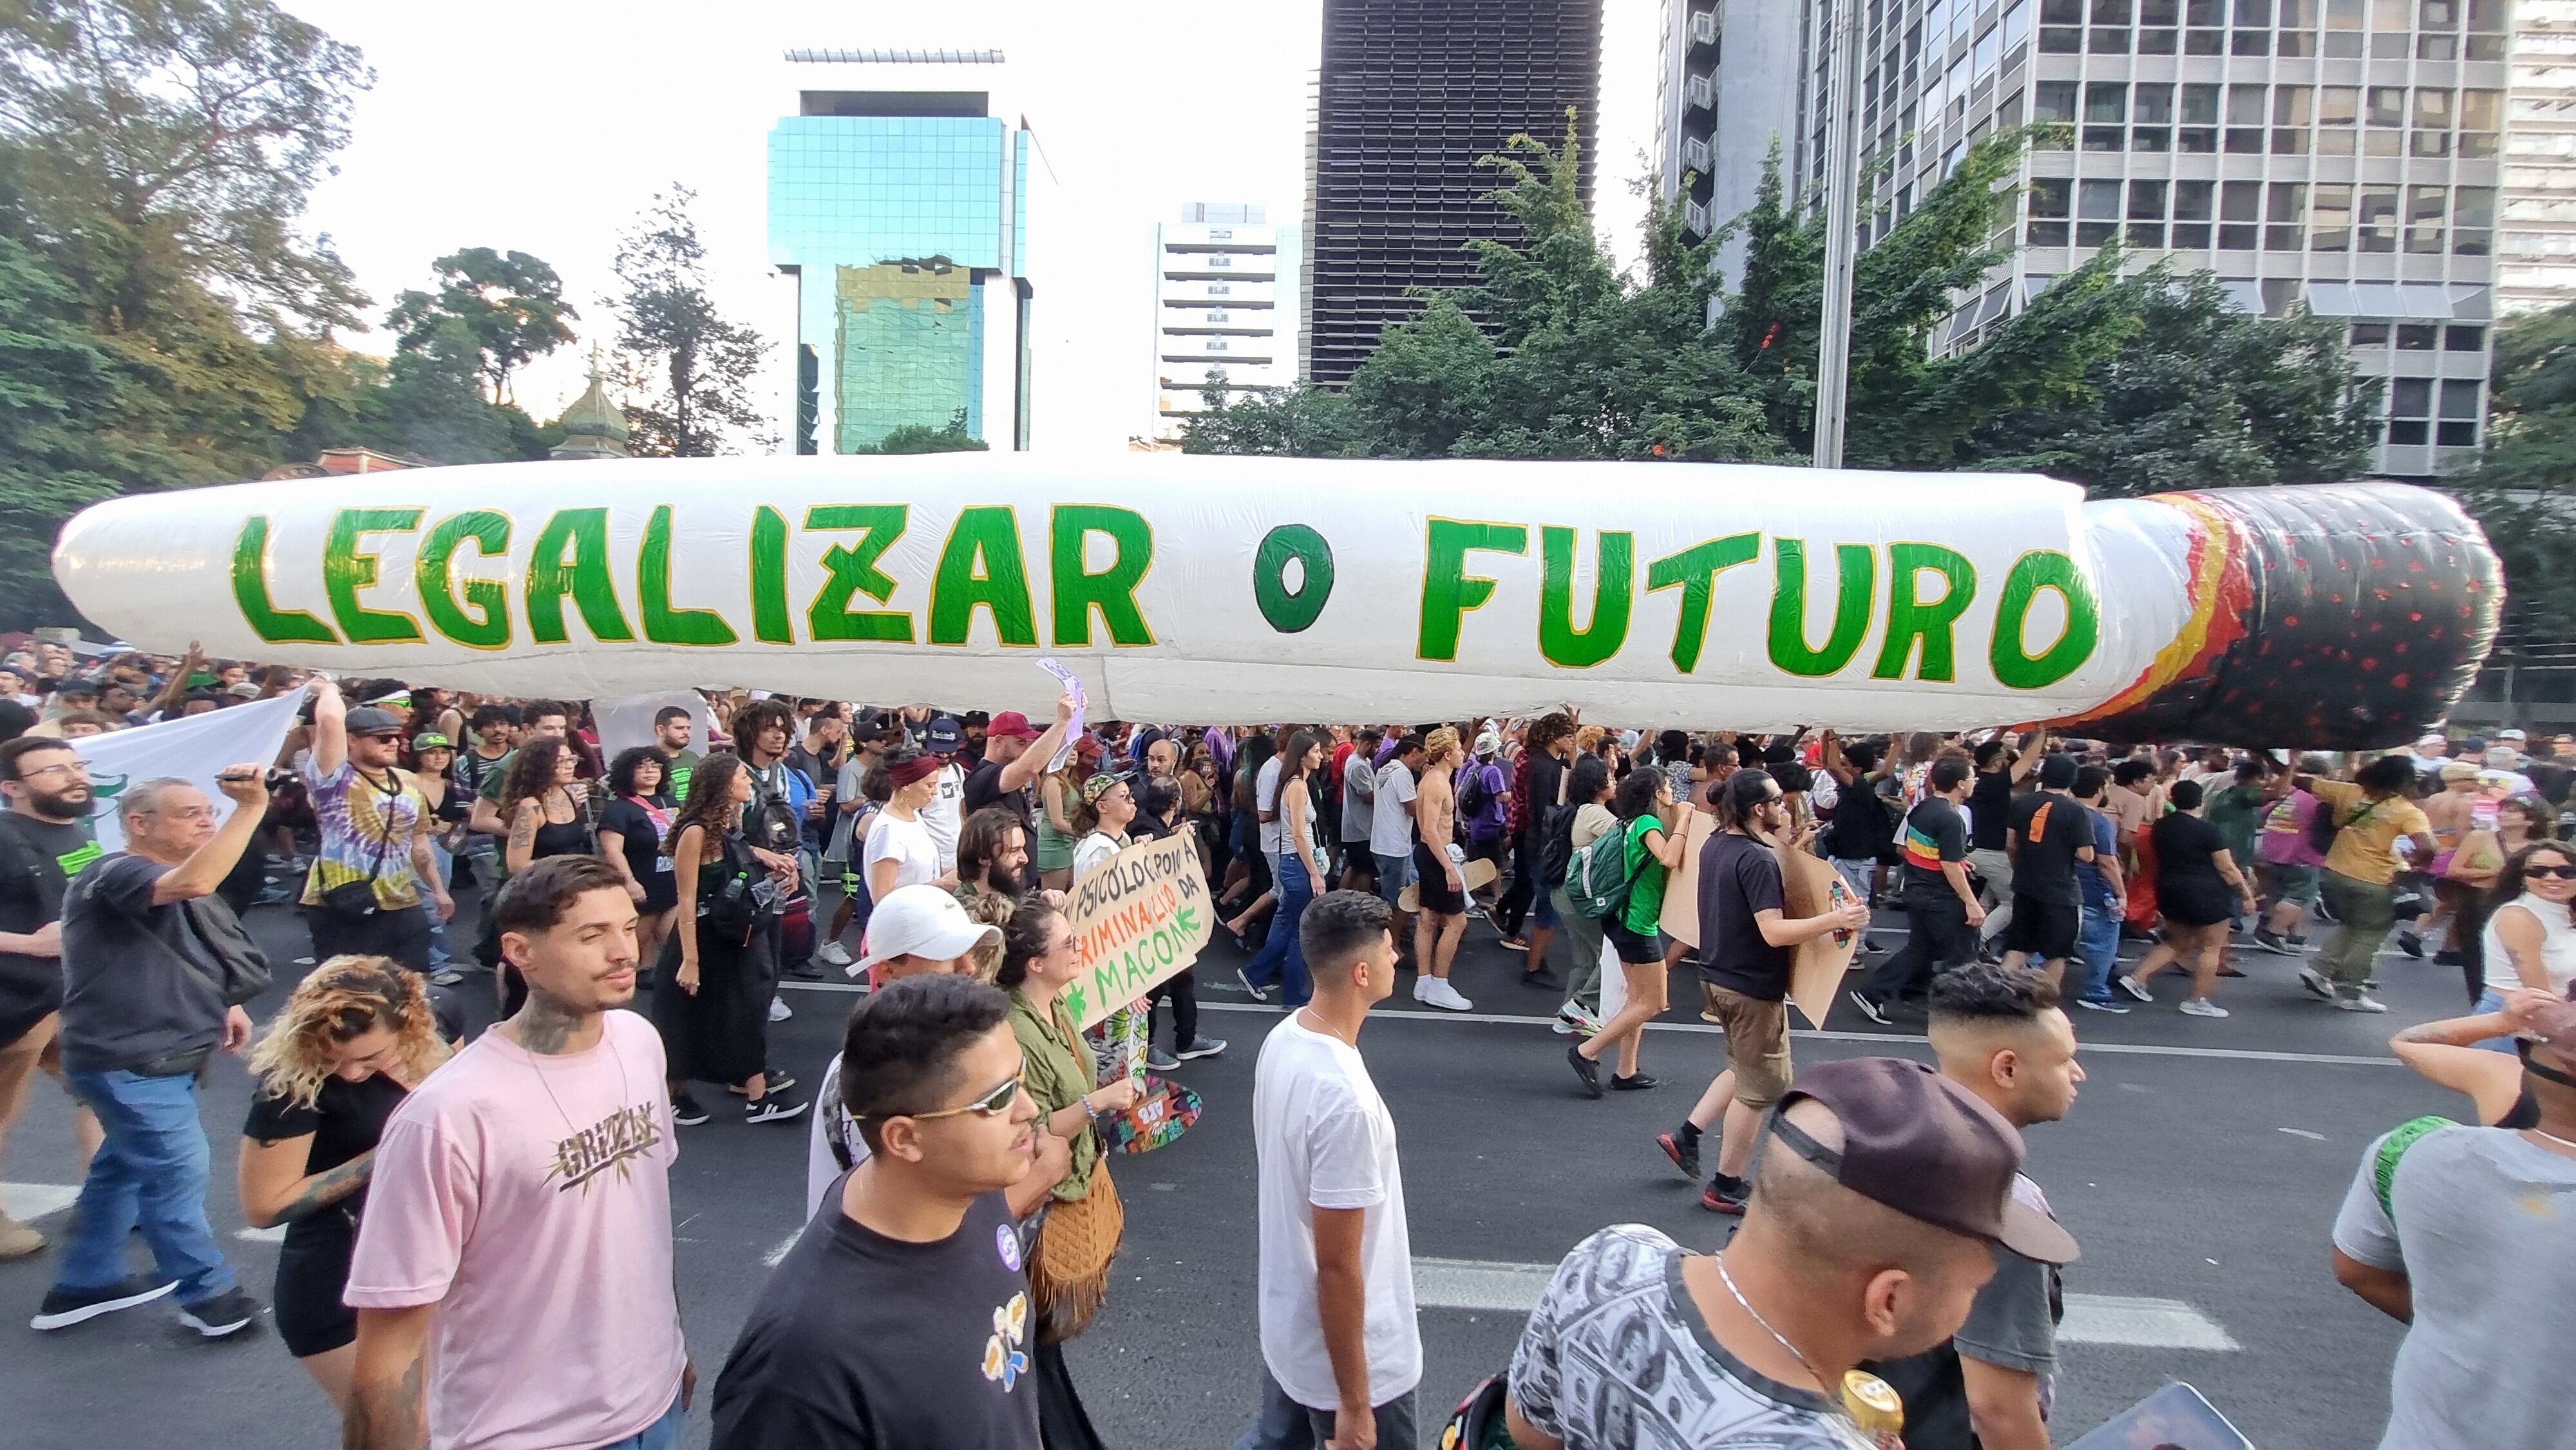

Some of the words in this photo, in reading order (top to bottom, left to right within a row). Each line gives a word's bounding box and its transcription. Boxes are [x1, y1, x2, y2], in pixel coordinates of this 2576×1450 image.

[230, 503, 1159, 650] LEGALIZAR
[1253, 523, 1335, 634] O
[1416, 514, 2101, 690] FUTURO
[1183, 837, 1197, 863] A
[1177, 872, 1200, 900] DA
